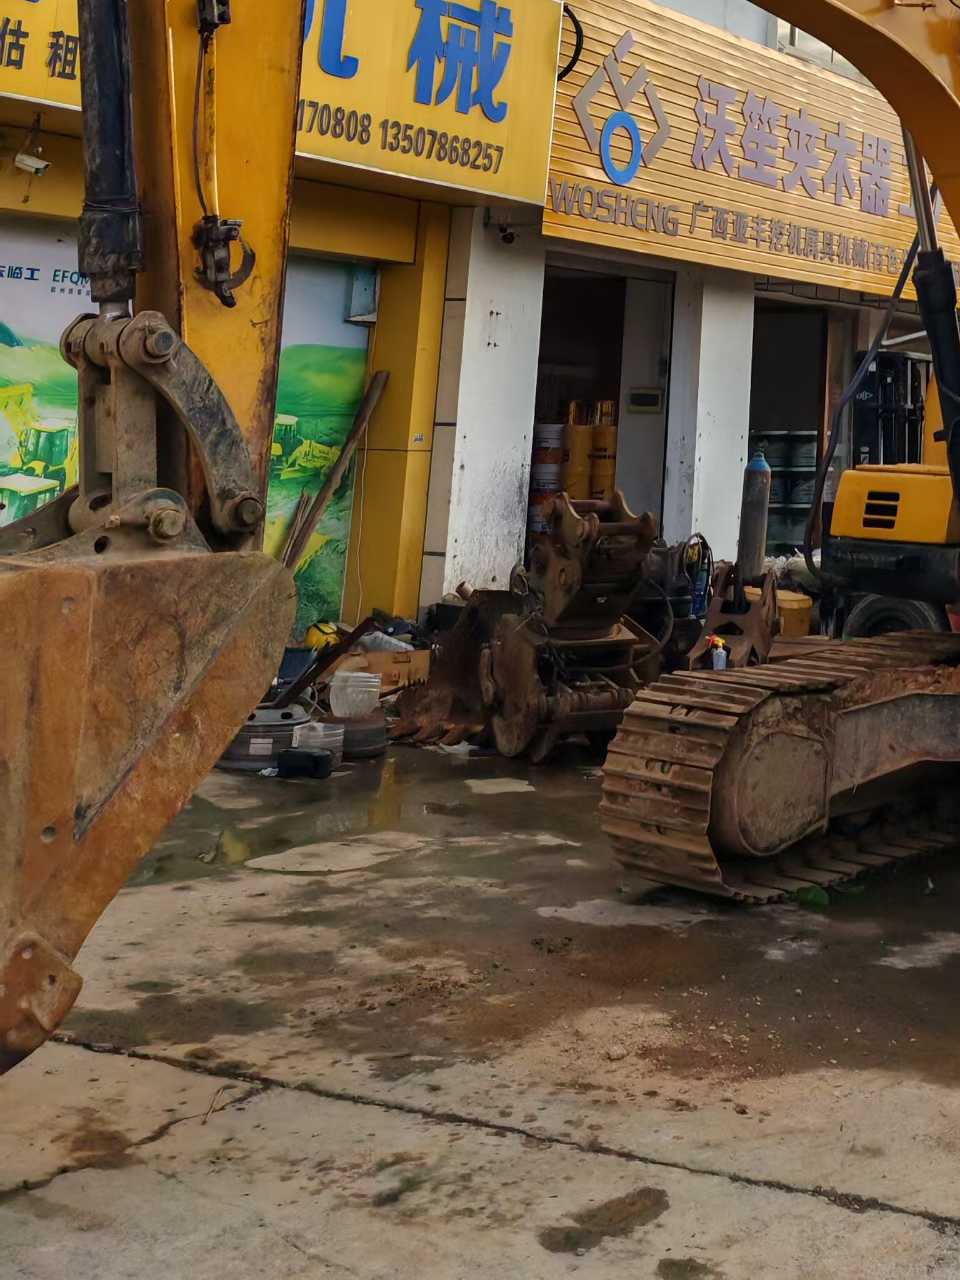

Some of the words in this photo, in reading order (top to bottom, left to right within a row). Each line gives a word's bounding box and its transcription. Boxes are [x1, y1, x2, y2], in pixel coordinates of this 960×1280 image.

[378, 118, 505, 175] 13507868257
[690, 73, 943, 226] 沃笙夹木器
[550, 175, 679, 237] WOSHENG
